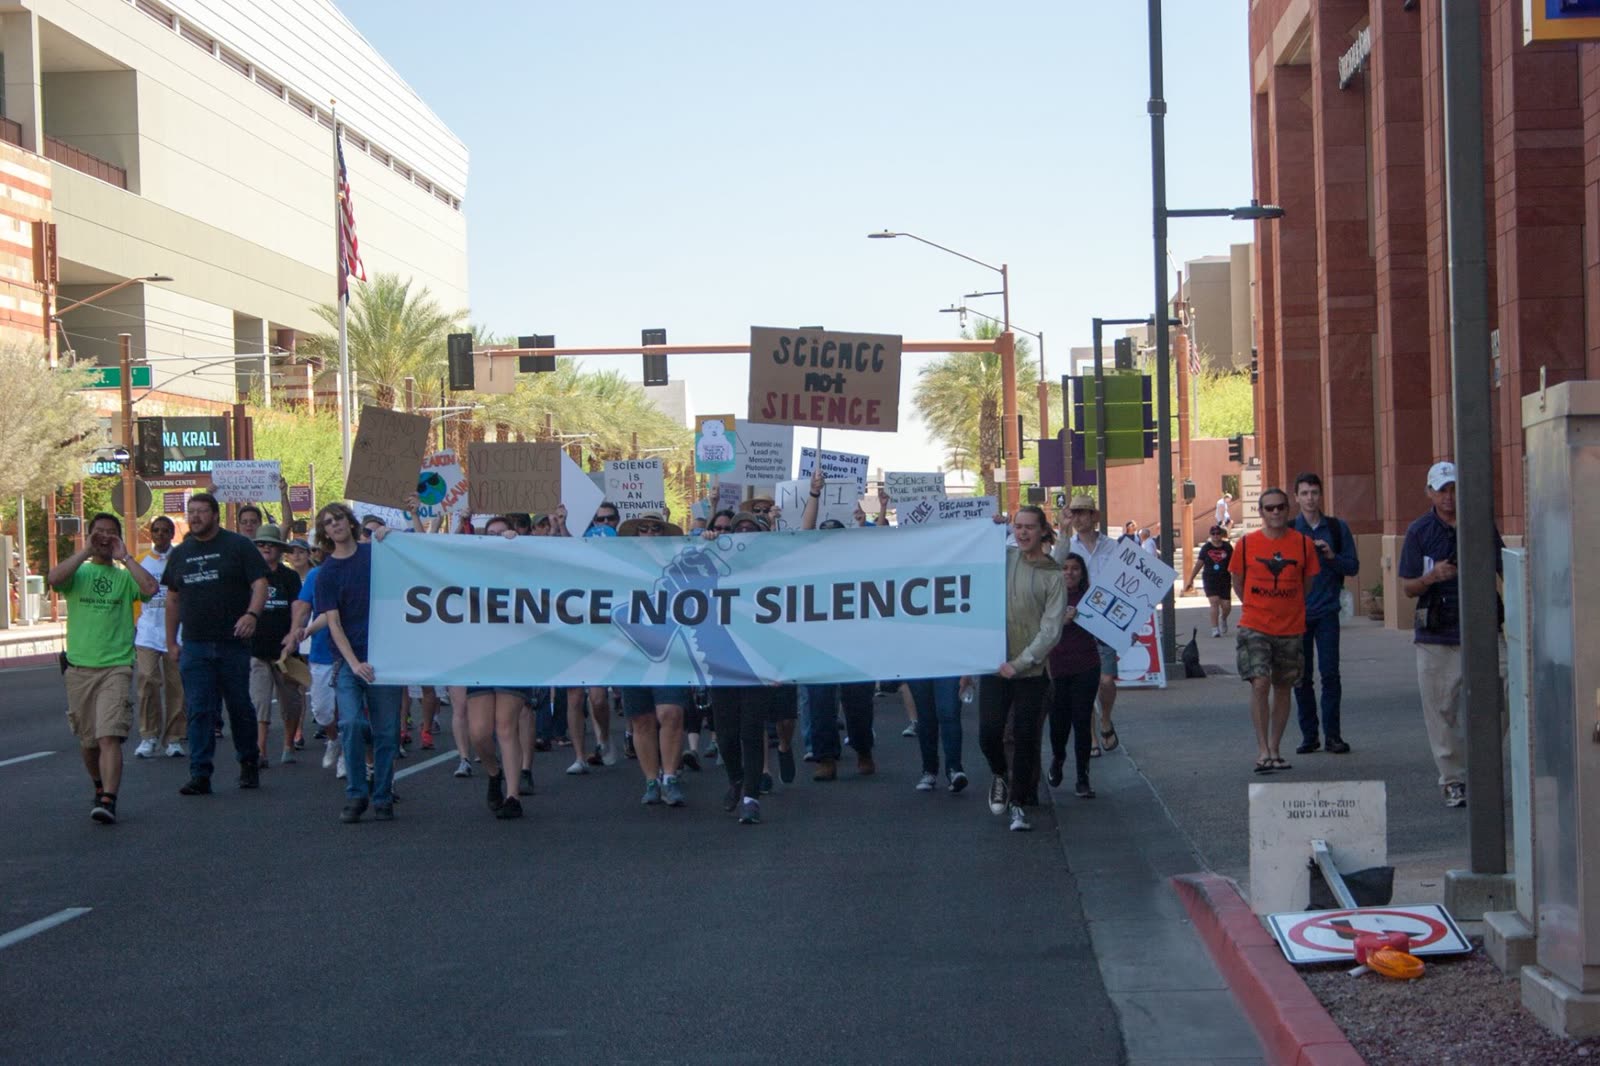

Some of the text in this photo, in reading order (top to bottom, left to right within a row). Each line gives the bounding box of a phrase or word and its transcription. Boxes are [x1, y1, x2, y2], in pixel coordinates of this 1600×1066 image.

[761, 391, 881, 425] SILENCE
[182, 431, 220, 447] KRALL
[368, 453, 396, 472] FOR
[468, 447, 556, 475] NO SCIENCE
[748, 456, 773, 465] Mercury
[802, 449, 868, 465] Scince Said It
[163, 460, 214, 472] PHONY HA
[850, 466, 857, 475] It
[219, 475, 266, 484] SCIENCE
[801, 469, 812, 477] Th
[856, 476, 863, 484] It
[934, 476, 943, 484] IS
[622, 482, 645, 490] NOT
[888, 487, 908, 495] TRUE
[440, 478, 470, 513] AGAIN
[468, 480, 560, 511] NO PROGRESS
[627, 491, 642, 499] AN
[939, 499, 990, 511] BECAUSE YOU
[963, 508, 984, 519] JUST
[1119, 547, 1164, 589] NO Science
[1114, 571, 1140, 595] NO
[405, 574, 972, 626] SCIENCE NOT SILENCE!
